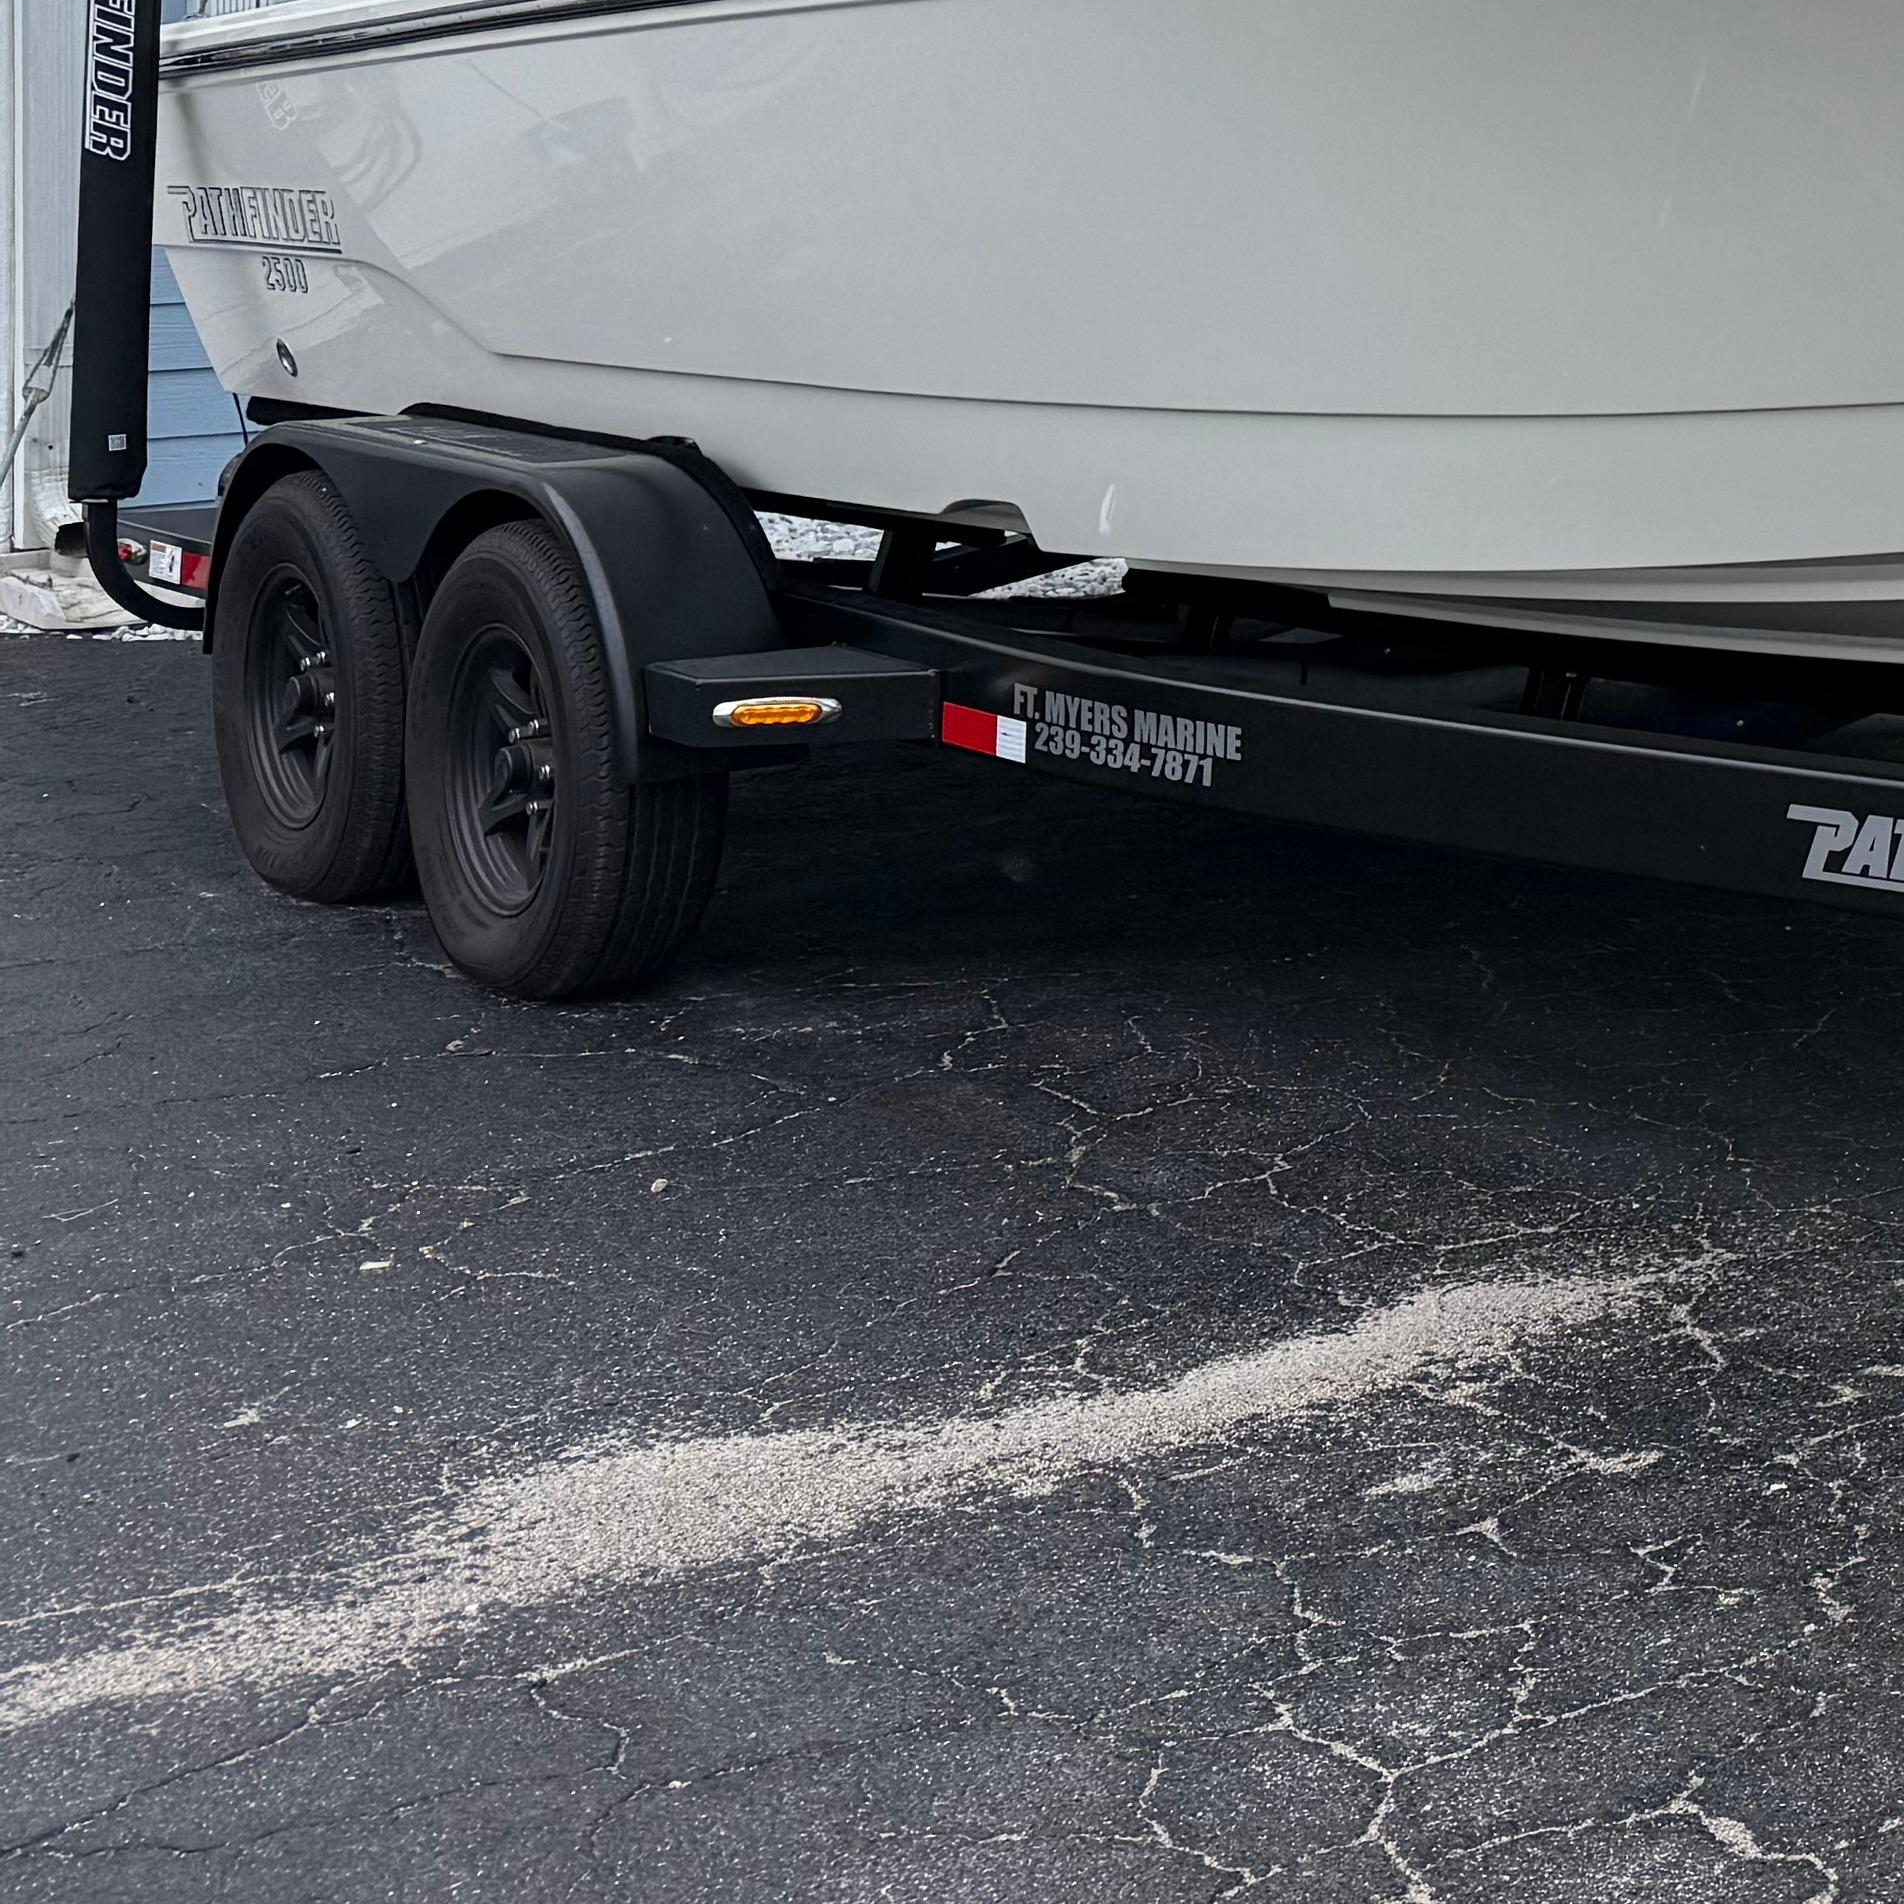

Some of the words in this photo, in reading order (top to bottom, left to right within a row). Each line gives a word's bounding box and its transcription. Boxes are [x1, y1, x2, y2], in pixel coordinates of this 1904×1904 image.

[166, 184, 343, 255] PATHFINDER
[262, 255, 309, 294] 2500
[1013, 682, 1040, 720] FT.
[1044, 690, 1128, 740] MYERS
[1133, 708, 1242, 761] MARINE
[1034, 722, 1213, 788] 239-334-7871
